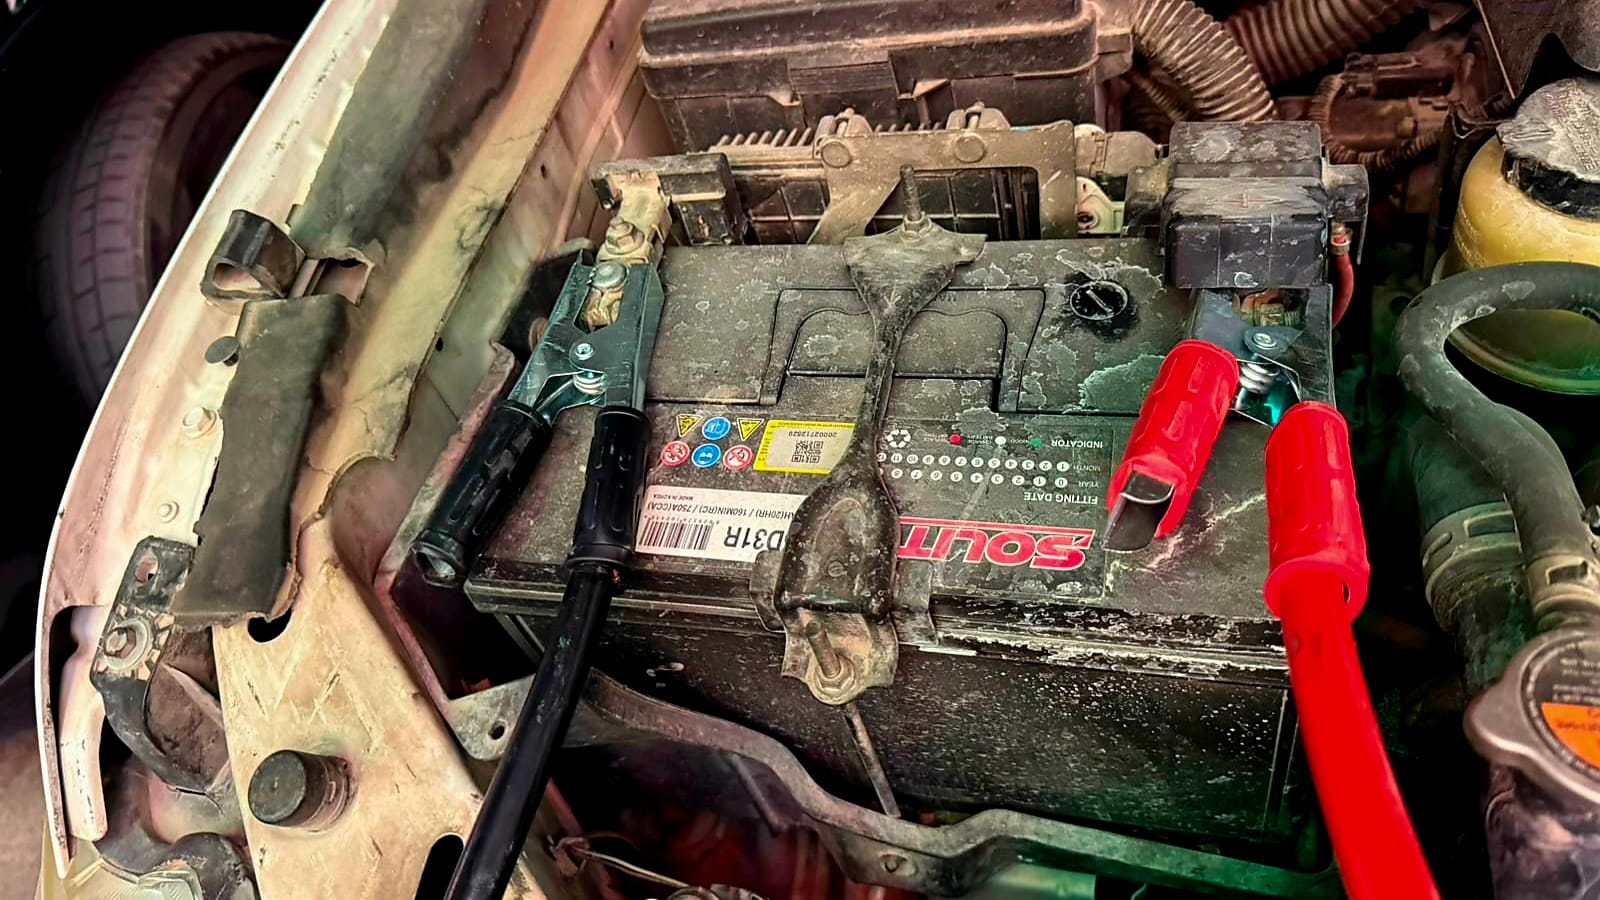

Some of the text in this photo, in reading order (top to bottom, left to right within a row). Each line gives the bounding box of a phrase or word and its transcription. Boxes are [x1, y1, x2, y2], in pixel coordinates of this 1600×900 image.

[1051, 439, 1103, 449] INDICATOR
[1078, 480, 1099, 488] YEAR
[1024, 491, 1098, 504] FITTING DATE
[648, 502, 693, 512] 750A(CCA)
[699, 504, 748, 516] 160MIN(RC)
